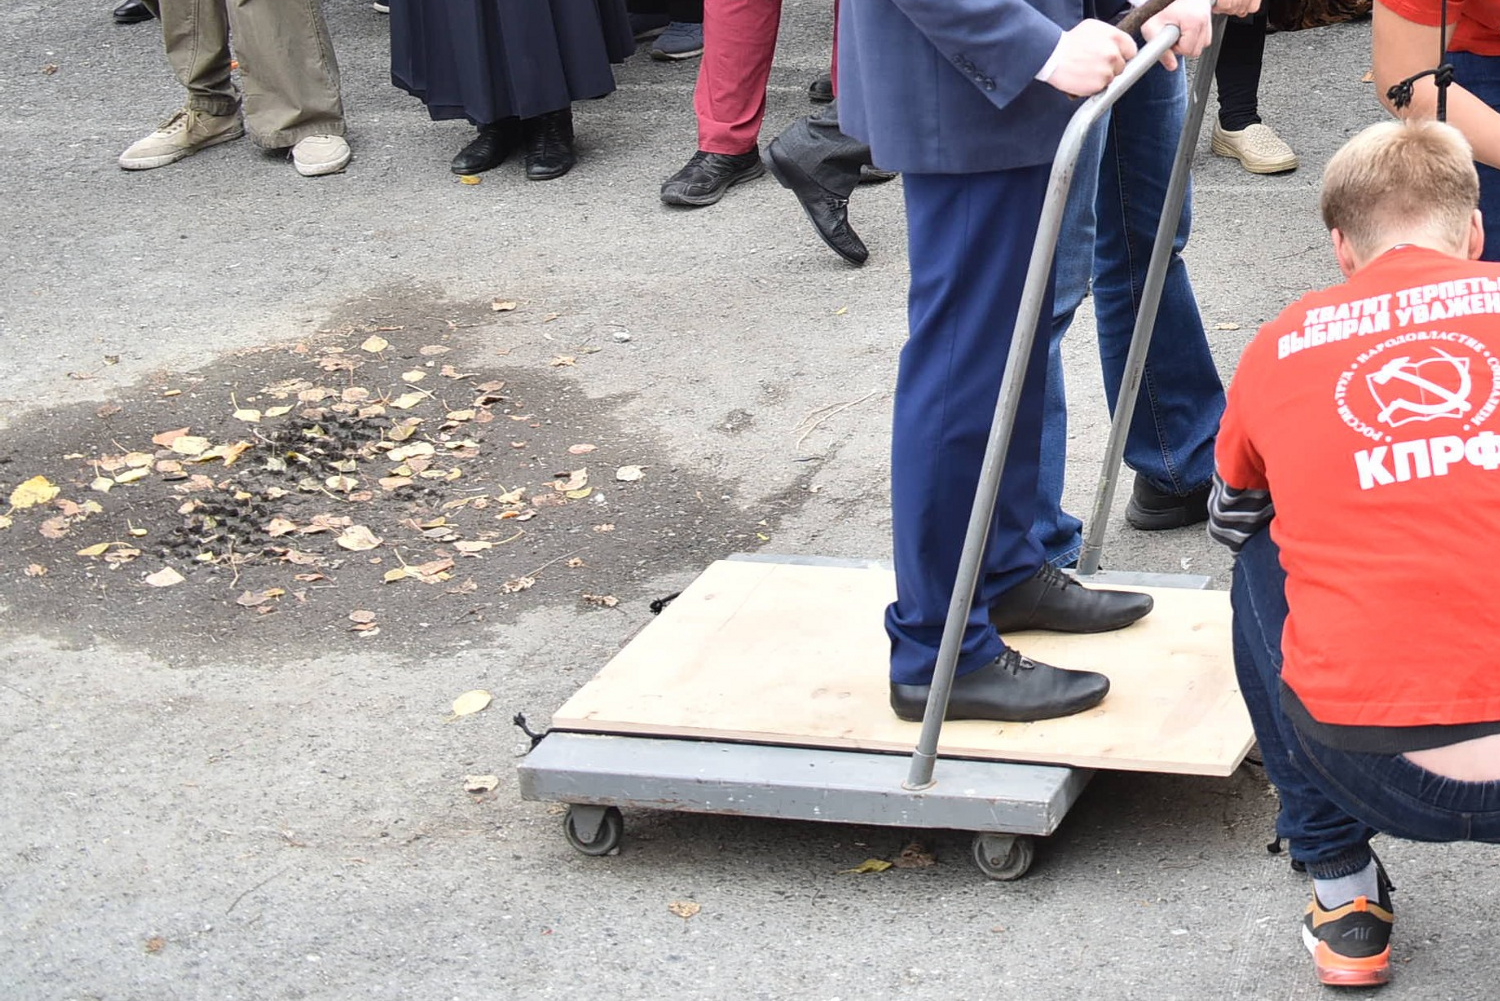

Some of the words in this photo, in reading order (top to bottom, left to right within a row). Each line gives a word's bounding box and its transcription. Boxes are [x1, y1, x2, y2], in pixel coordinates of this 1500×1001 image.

[1303, 293, 1392, 327] ХВАТИТ
[1356, 330, 1486, 364] НАРОДОВЛАСТИЕ
[1334, 370, 1355, 400] ТРУД
[1337, 404, 1384, 441] РОССИЯ
